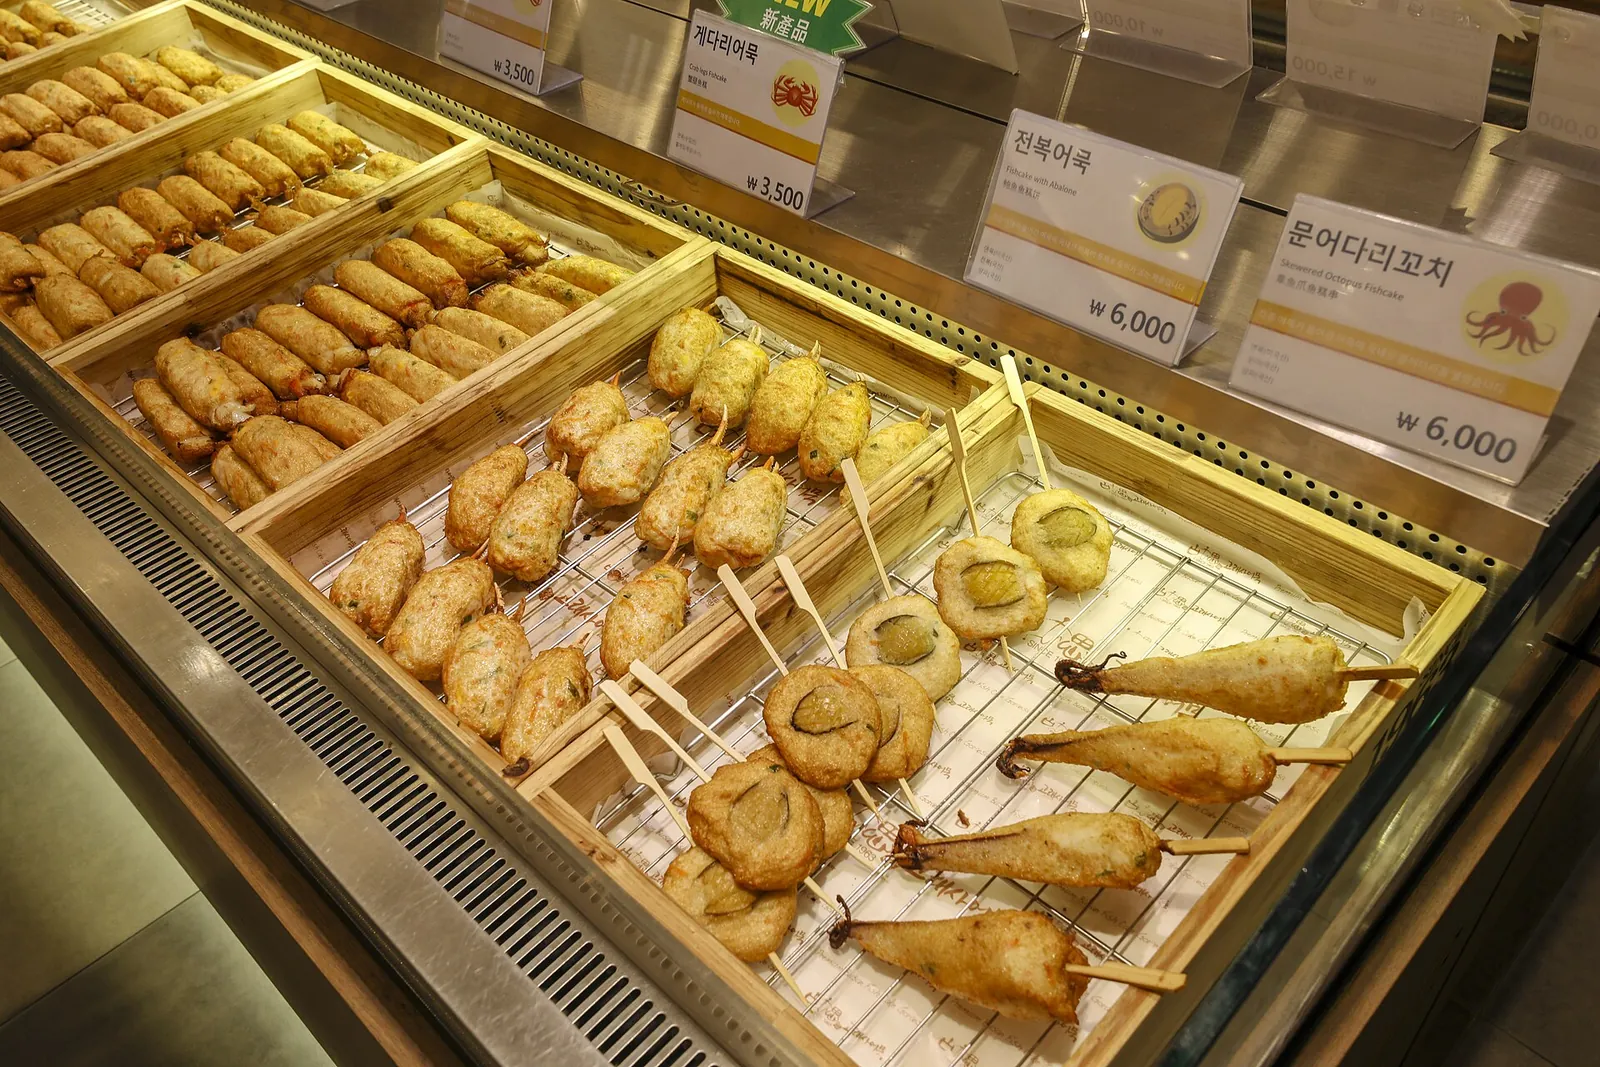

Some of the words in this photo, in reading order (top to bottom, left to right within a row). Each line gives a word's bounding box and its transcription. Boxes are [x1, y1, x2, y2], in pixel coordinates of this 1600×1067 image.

[693, 24, 760, 66] 게다리어묵
[503, 58, 535, 86] 3,500
[708, 69, 728, 84] Fishcake
[1014, 128, 1093, 175] 전복어묵
[760, 175, 804, 213] 3,500
[1005, 165, 1033, 181] Fishcake
[1033, 174, 1049, 187] with
[1048, 179, 1078, 197] Abalone
[1288, 220, 1455, 289] 문어다리꼬치
[1279, 258, 1324, 278] Skewered
[1325, 271, 1363, 291] Octopus
[1363, 281, 1405, 303] Fishcake
[1110, 302, 1176, 346] 6,000
[1425, 414, 1518, 464] 6,000
[855, 843, 877, 862] 1963
